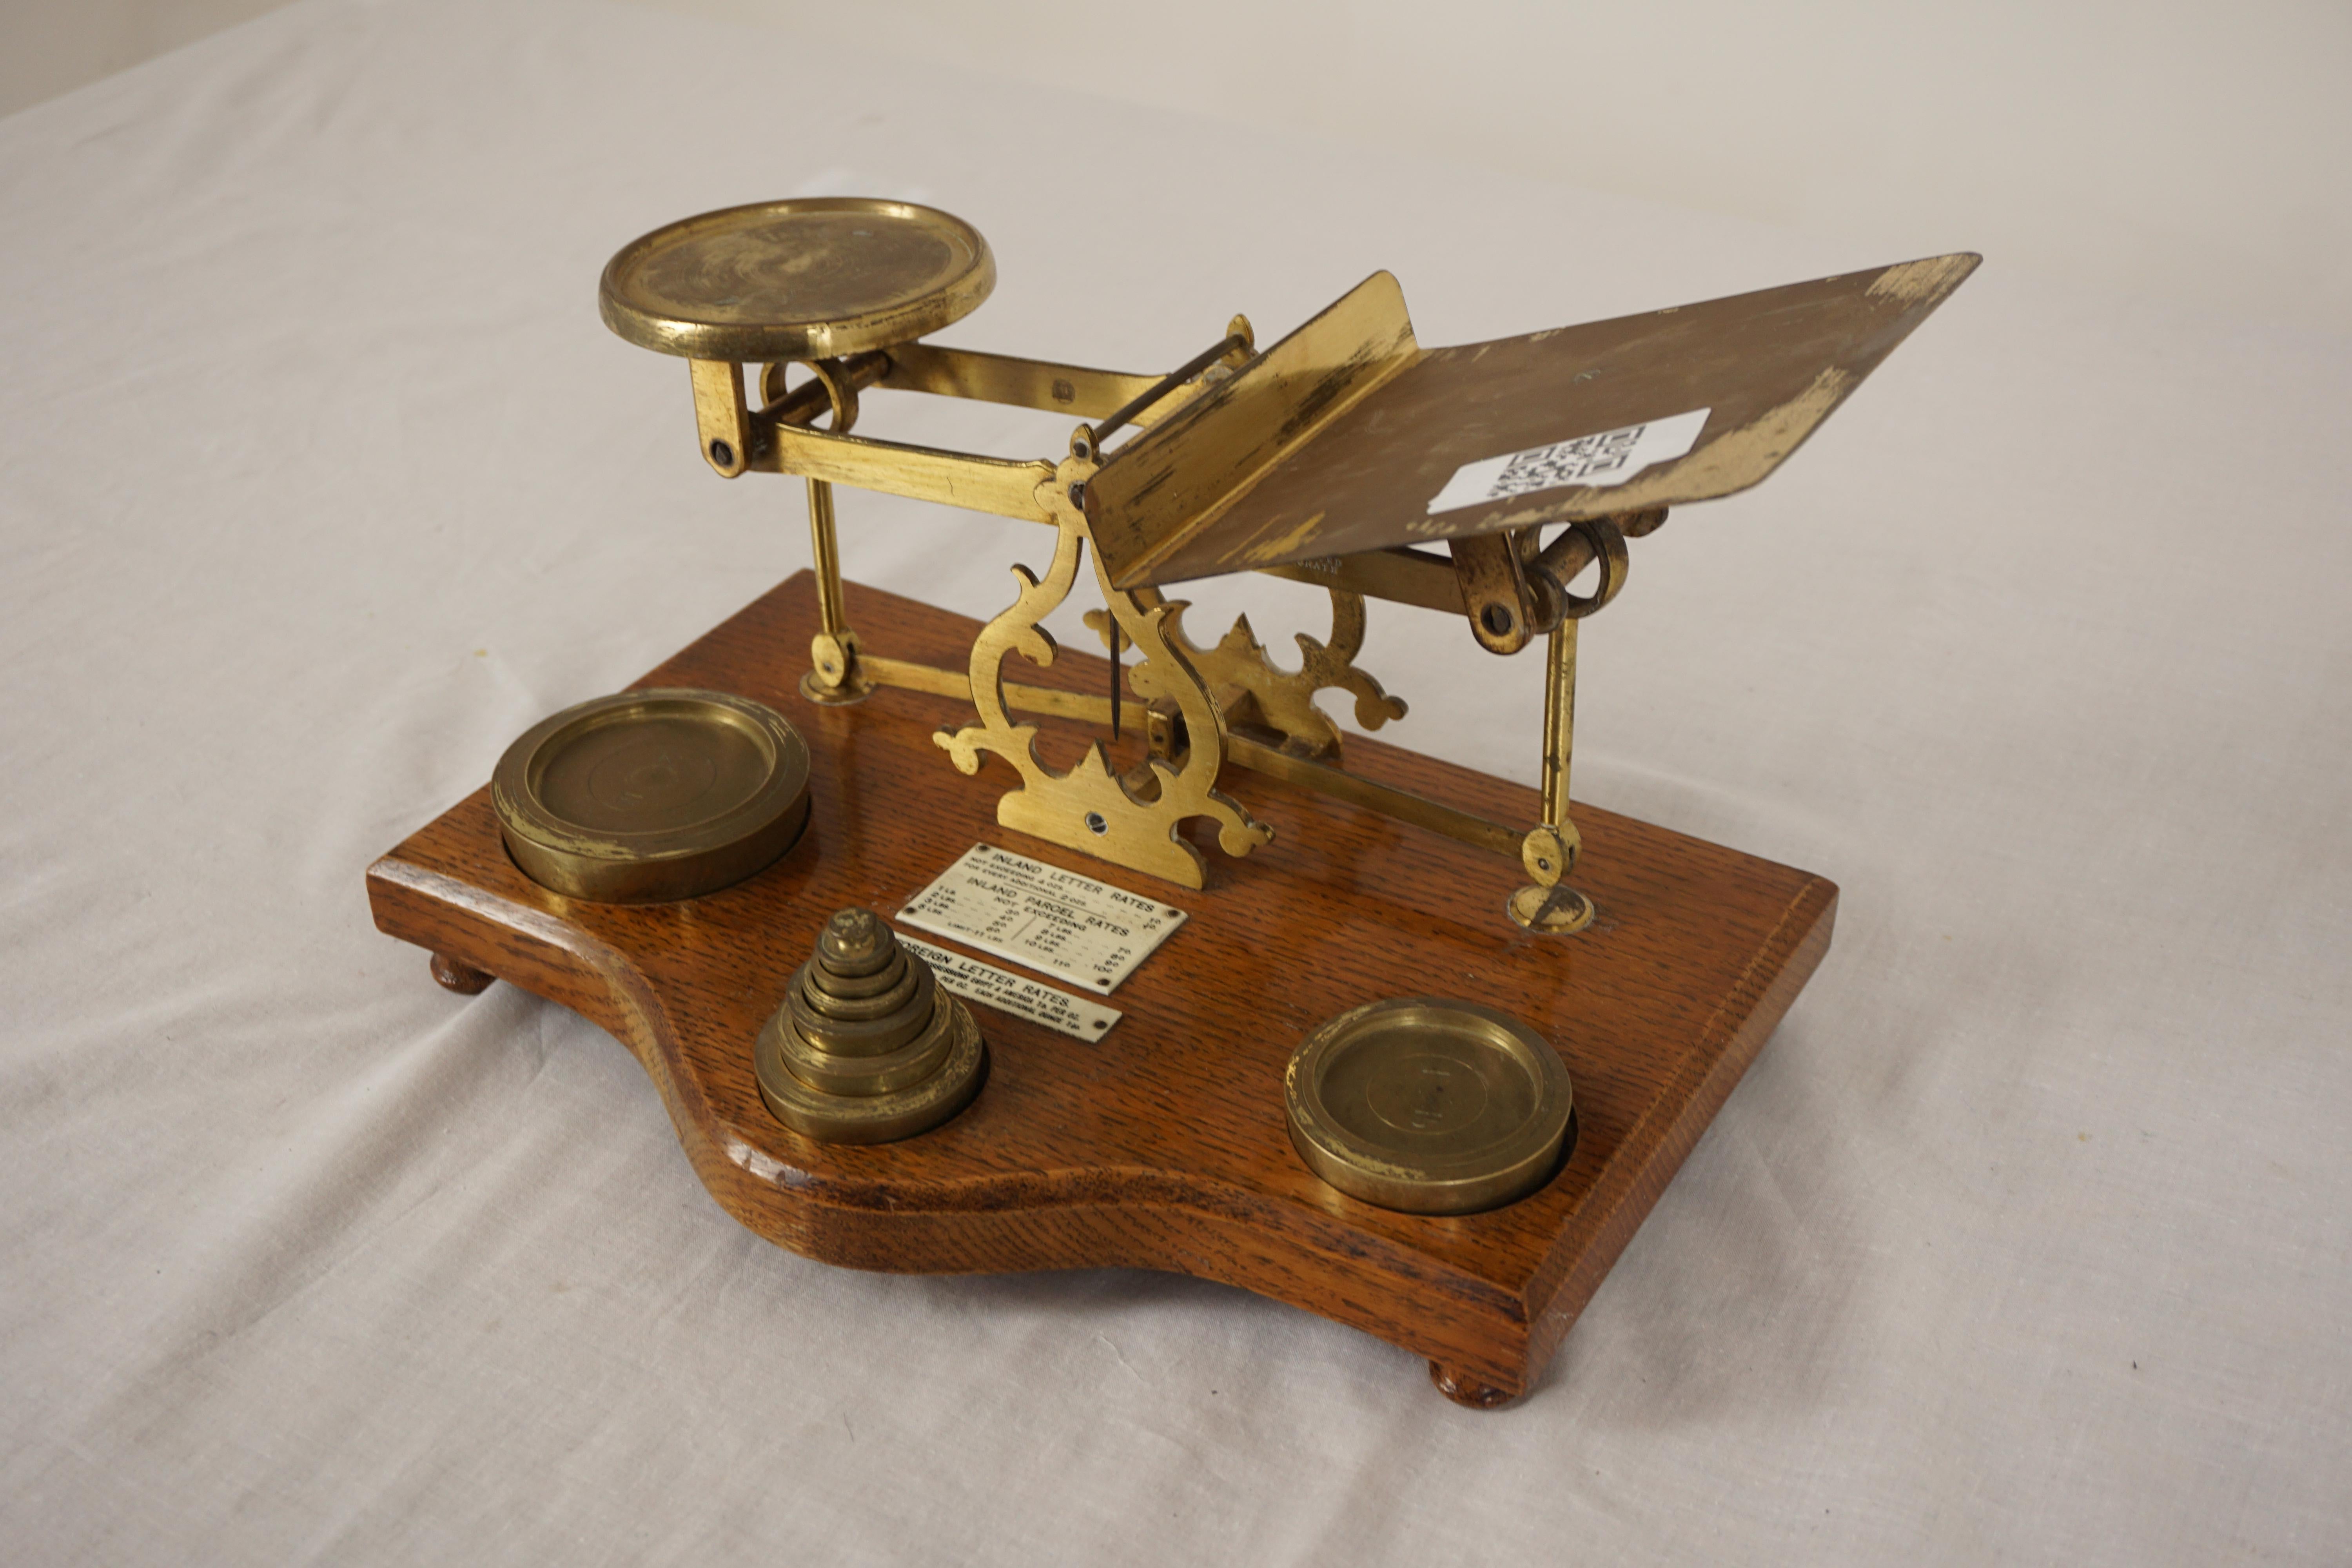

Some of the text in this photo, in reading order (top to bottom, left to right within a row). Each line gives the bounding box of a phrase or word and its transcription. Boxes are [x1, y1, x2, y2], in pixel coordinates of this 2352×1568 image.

[964, 862, 980, 871] FOR
[982, 868, 1007, 880] EVERY
[1009, 877, 1056, 897] ADDITIONAL
[970, 856, 987, 864] NOT
[989, 863, 1034, 881] EXCEEDING
[992, 853, 1154, 912] INLAND LETTER RATES
[967, 877, 1129, 936] INLAND PARCEL RATES
[993, 896, 1087, 931] NOT EXCEEDING
[958, 962, 1016, 987] LETTER
[940, 975, 955, 984] PER
[975, 988, 993, 998] EACH
[996, 996, 1036, 1014] ADDITIONAL
[1038, 1011, 1062, 1023] OUNCE
[970, 977, 993, 989] EGYPT
[1003, 989, 1033, 1004] AMERICA
[1050, 1006, 1066, 1016] PER
